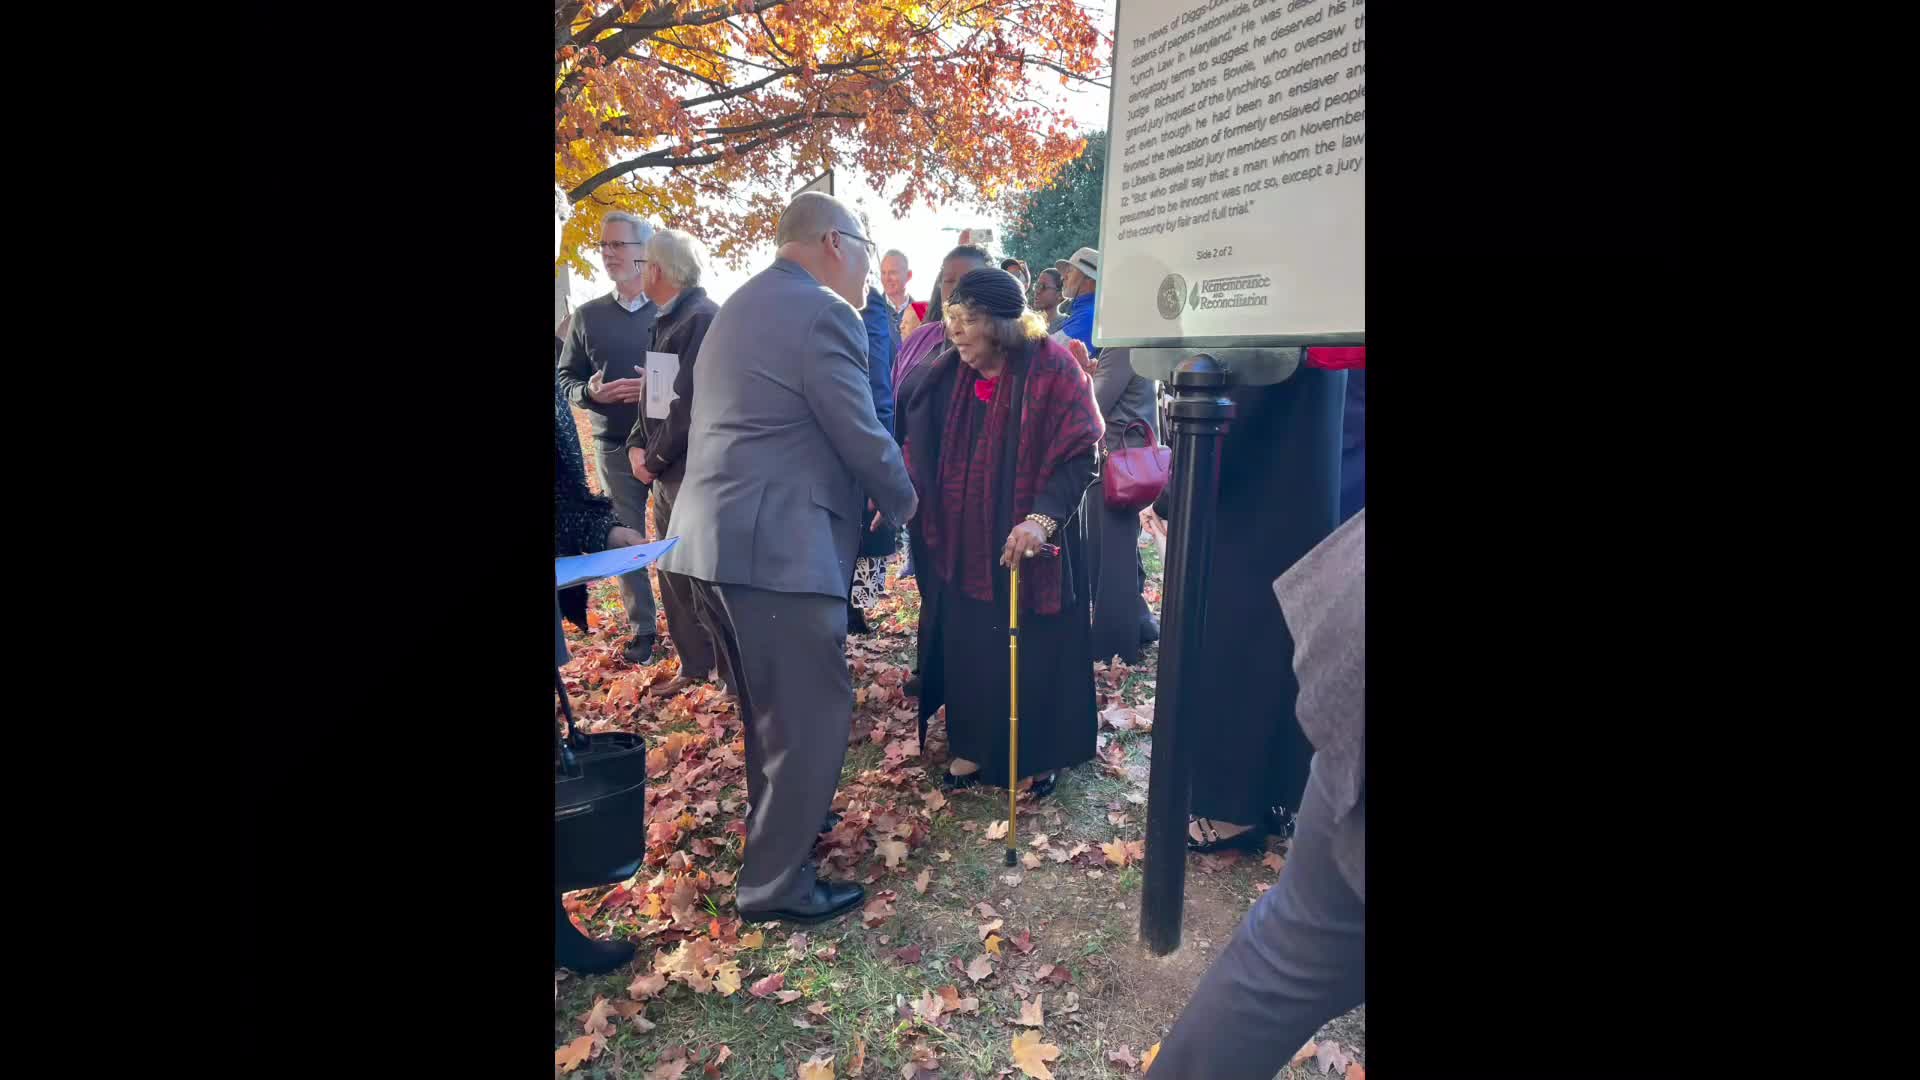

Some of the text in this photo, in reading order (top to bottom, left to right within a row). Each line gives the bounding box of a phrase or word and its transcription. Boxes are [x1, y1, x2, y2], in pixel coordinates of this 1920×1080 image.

[1129, 78, 1169, 103] derogatory
[1171, 66, 1196, 84] terms
[1198, 60, 1208, 72] to
[1211, 41, 1249, 67] suggest
[1253, 35, 1266, 48] he
[1270, 8, 1323, 41] deserved
[1327, 0, 1346, 18] his
[1131, 48, 1158, 68] dozens
[1158, 40, 1168, 54] of
[1167, 29, 1196, 51] papers
[1197, 3, 1250, 35] nationwide,
[1133, 37, 1146, 49] The
[1148, 25, 1169, 42] news
[1170, 15, 1180, 31] of
[1157, 58, 1174, 72] Law
[1177, 51, 1186, 64] in
[1241, 19, 1256, 34] He
[1260, 8, 1282, 24] was
[1125, 121, 1147, 141] grand
[1147, 116, 1163, 133] jury
[1165, 101, 1197, 122] inquest
[1197, 95, 1208, 110] of
[1208, 92, 1225, 106] the
[1225, 74, 1272, 101] lynching,
[1274, 42, 1349, 80] condemned
[1127, 104, 1150, 121] Judge
[1154, 87, 1185, 109] Richard
[1189, 75, 1217, 95] Johns
[1223, 60, 1256, 81] Bowie,
[1262, 48, 1287, 64] who
[1294, 23, 1346, 53] oversaw
[1122, 153, 1150, 173] favored
[1151, 151, 1166, 164] the
[1166, 136, 1209, 159] relocation
[1210, 128, 1222, 144] of
[1223, 116, 1267, 140] formerly
[1269, 96, 1321, 125] enslaved
[1124, 143, 1136, 157] act
[1138, 136, 1157, 151] even
[1160, 121, 1192, 142] though
[1195, 117, 1208, 130] he
[1212, 105, 1231, 125] had
[1236, 98, 1262, 116] been
[1267, 91, 1282, 104] an
[1288, 71, 1340, 97] enslaver
[1119, 155, 1364, 226] presumed to be innocent was not so, except a jury
[1121, 180, 1130, 192] to
[1159, 161, 1185, 179] Bowie
[1186, 153, 1205, 170] told
[1204, 150, 1225, 168] jury
[1226, 134, 1278, 159] members
[1280, 129, 1296, 142] on
[1150, 187, 1168, 200] who
[1168, 177, 1190, 194] shall
[1191, 175, 1207, 188] say
[1209, 167, 1229, 182] that
[1232, 166, 1239, 176] a
[1242, 158, 1268, 175] man
[1271, 146, 1310, 166] whom
[1315, 139, 1336, 155] the
[1341, 132, 1365, 148] law
[1118, 228, 1126, 241] of
[1126, 228, 1138, 239] the
[1138, 222, 1165, 236] county
[1165, 219, 1177, 233] by
[1177, 215, 1192, 228] fair
[1192, 210, 1210, 225] and
[1211, 205, 1227, 221] full
[1195, 245, 1233, 260] Side 2 of 2
[1199, 292, 1268, 309] Reconciliation
[1201, 276, 1271, 293] Remembrance
